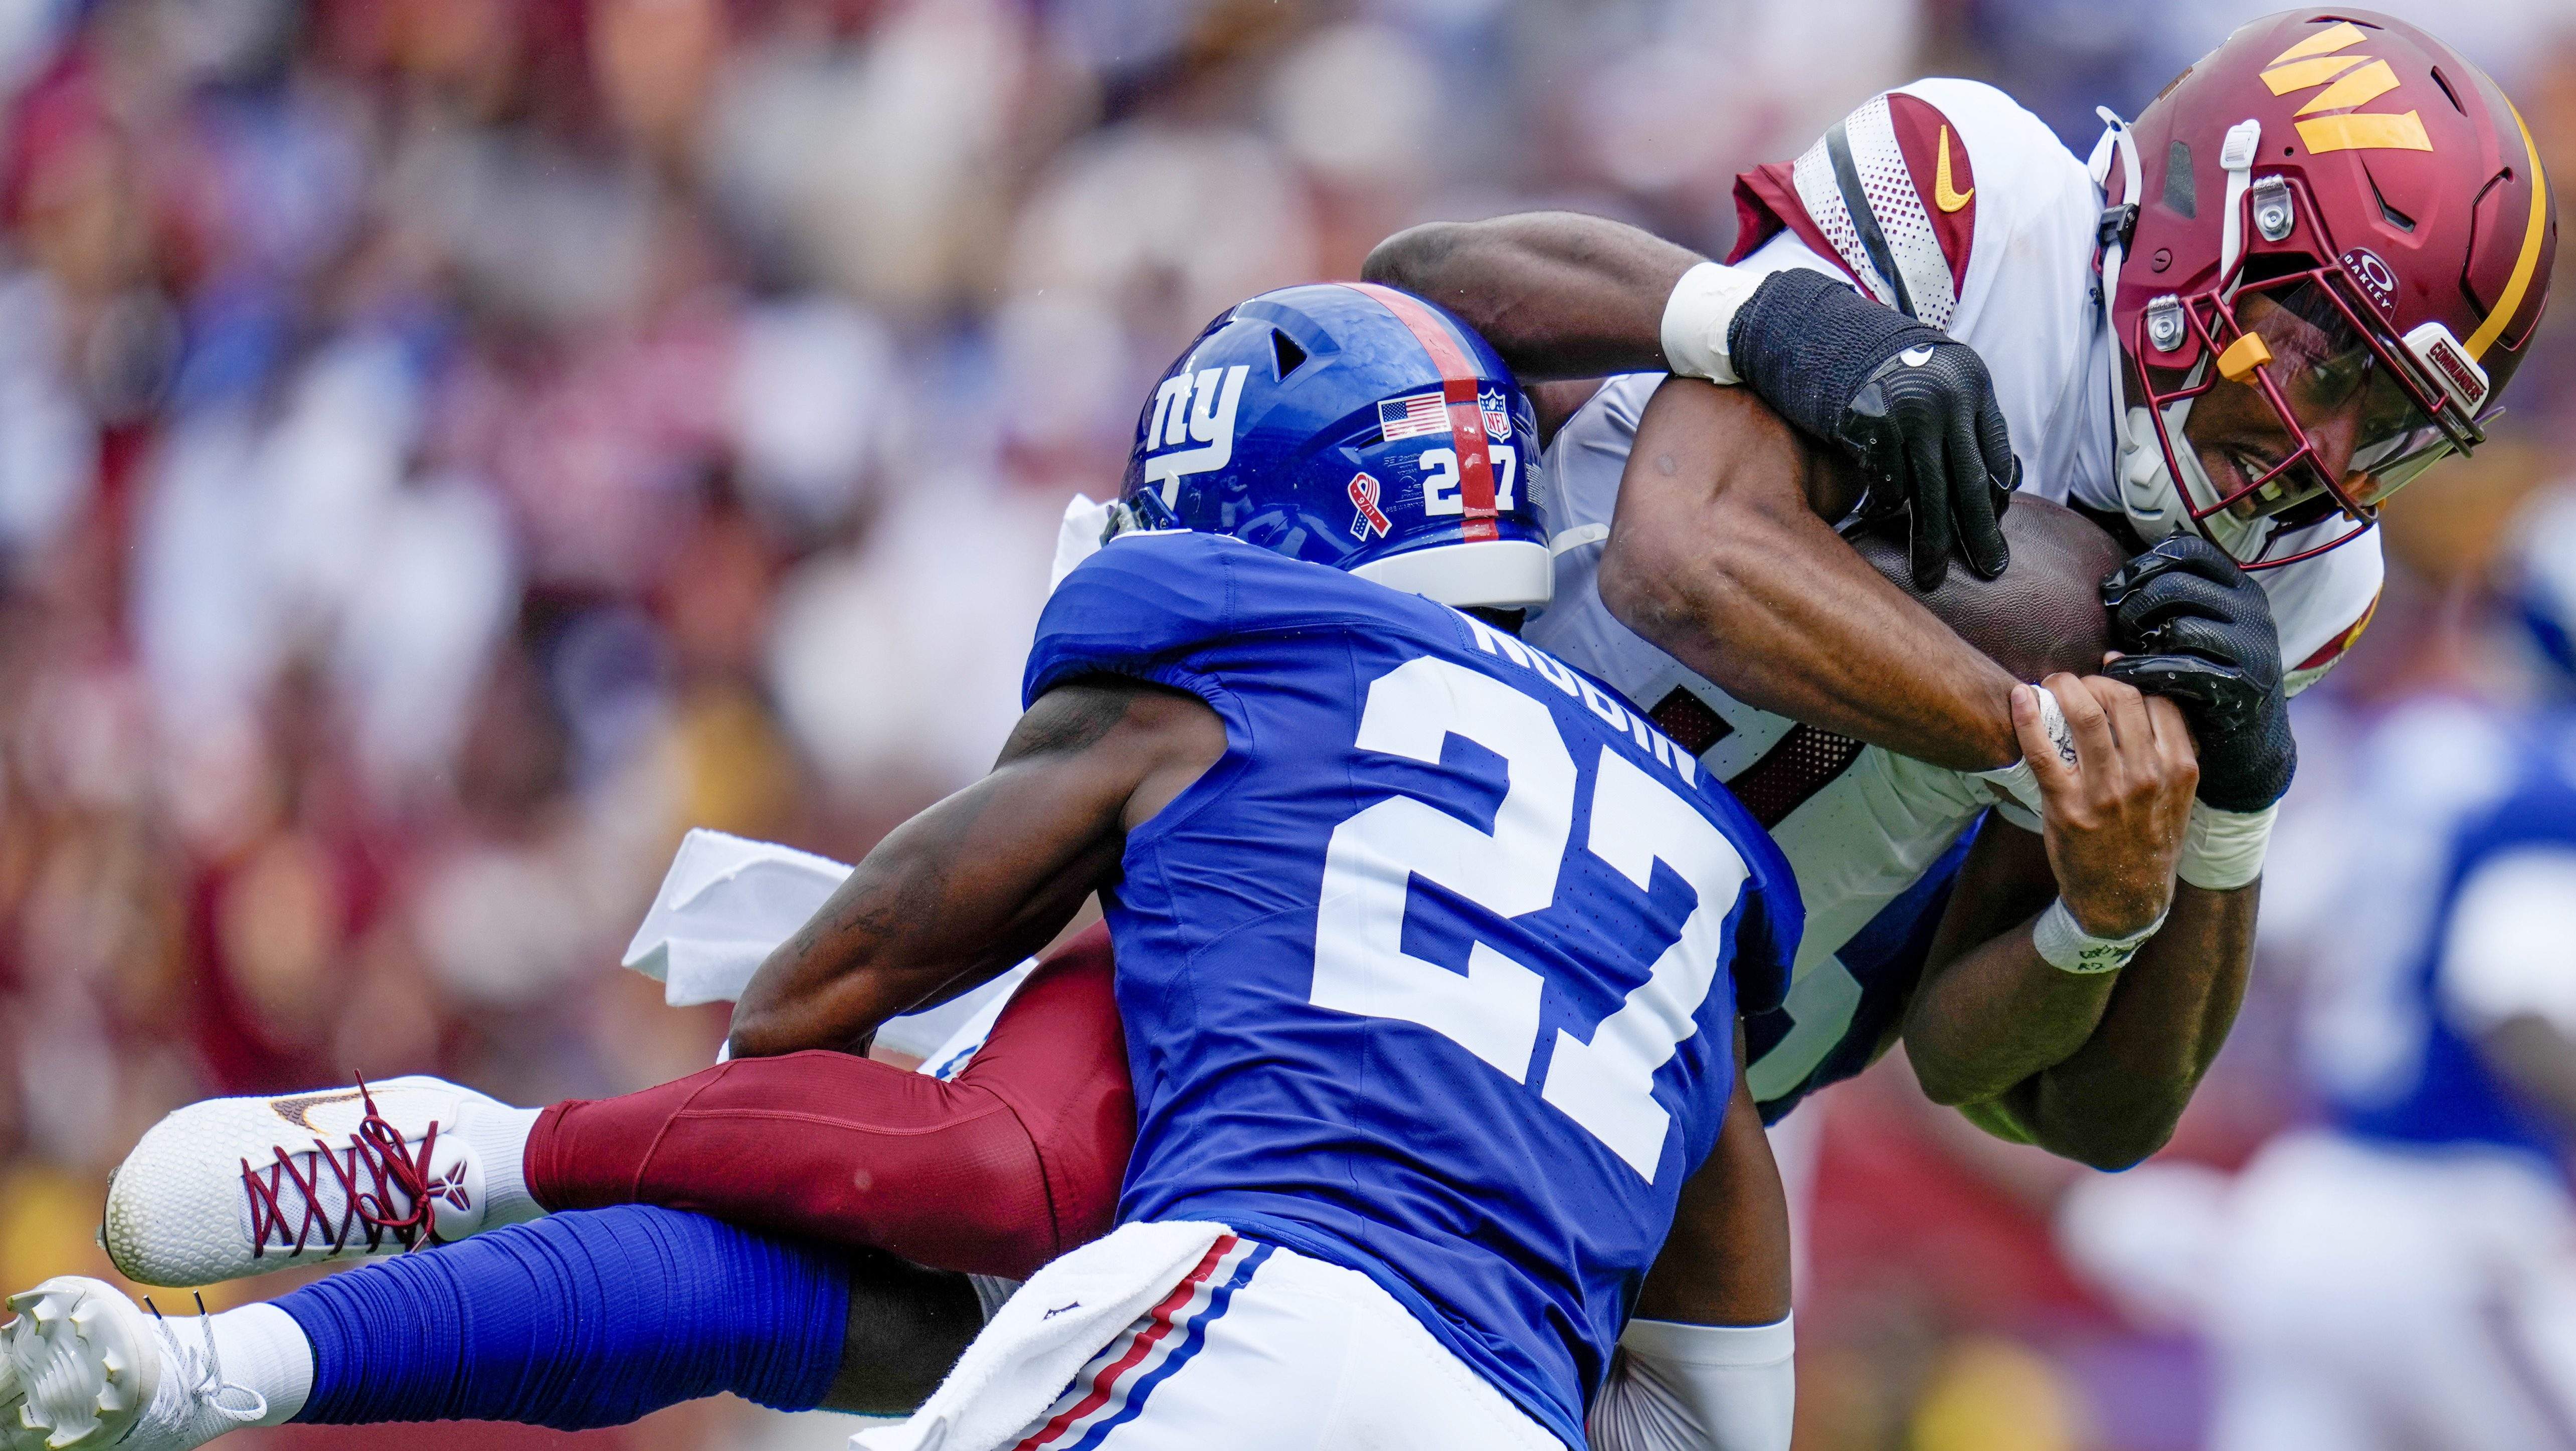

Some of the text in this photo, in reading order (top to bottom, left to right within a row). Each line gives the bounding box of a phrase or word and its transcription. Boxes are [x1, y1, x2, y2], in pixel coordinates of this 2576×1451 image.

[2344, 254, 2390, 308] OAKLEY
[1486, 412, 1508, 433] NFL
[1357, 497, 1375, 516] 9/11
[1419, 445, 1516, 516] 27
[1309, 654, 1750, 1186] 27
